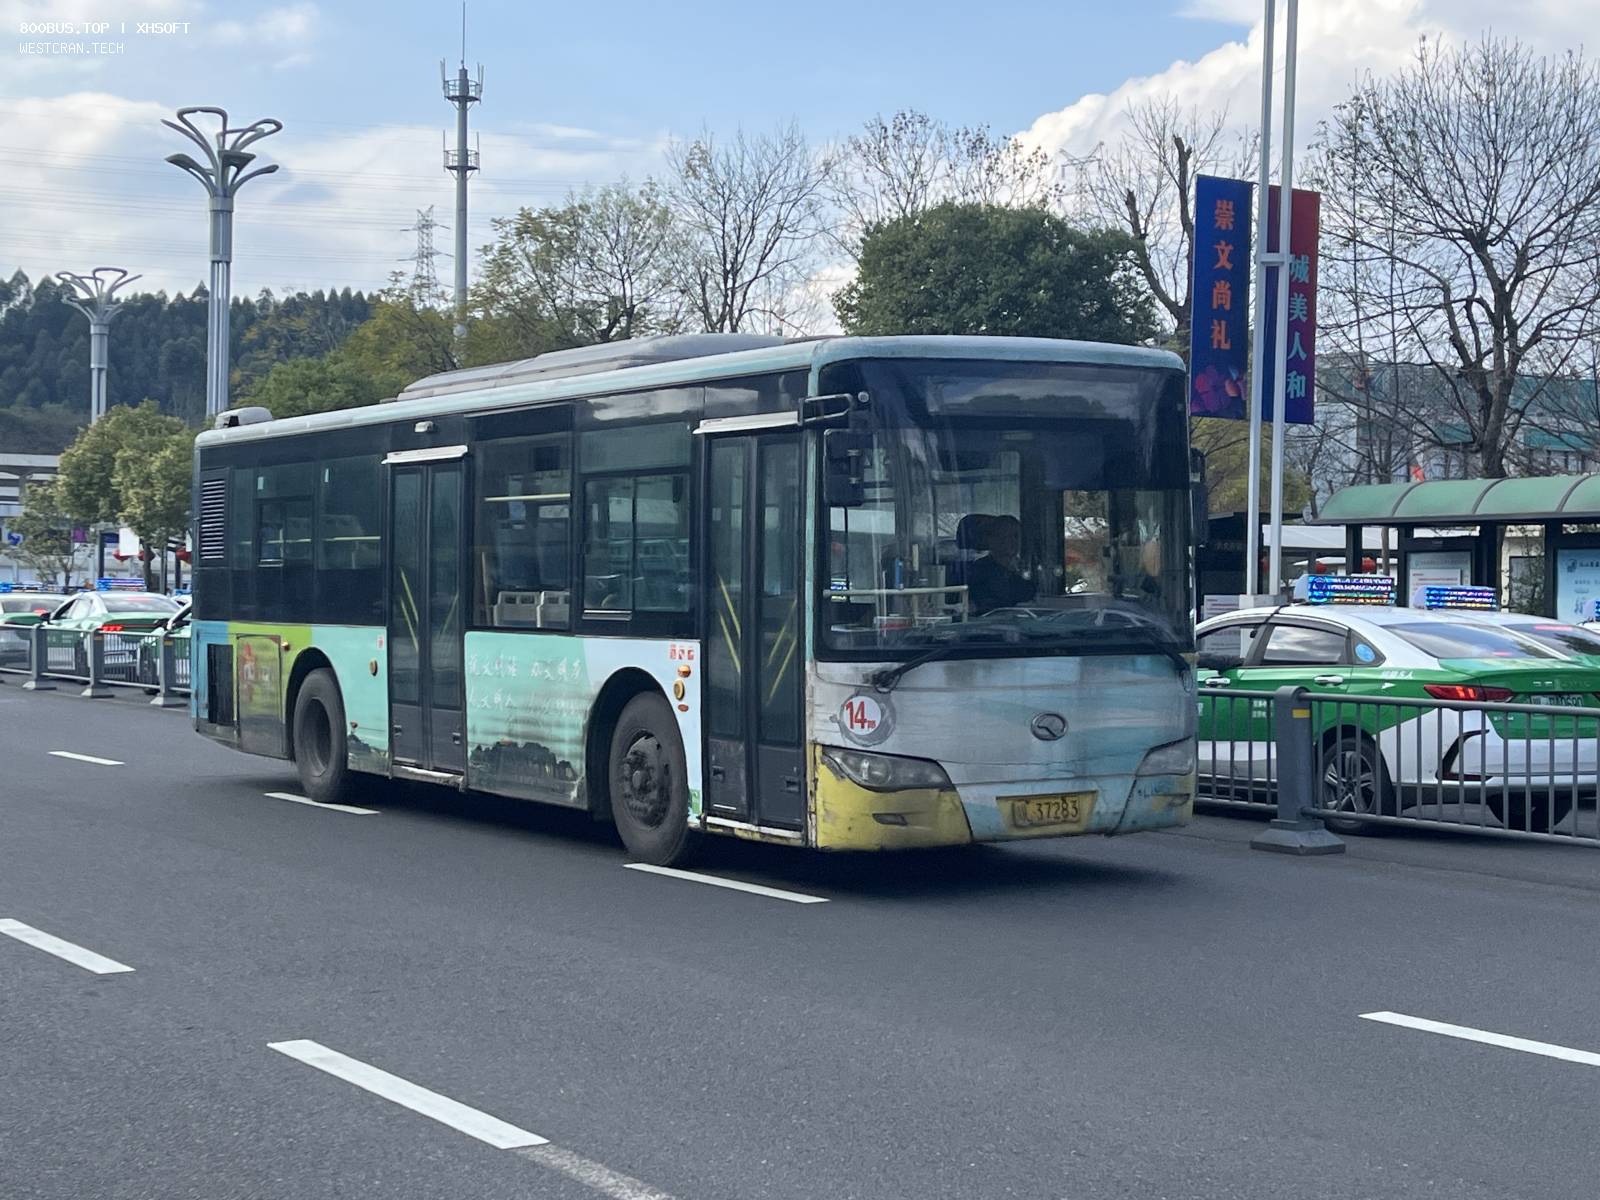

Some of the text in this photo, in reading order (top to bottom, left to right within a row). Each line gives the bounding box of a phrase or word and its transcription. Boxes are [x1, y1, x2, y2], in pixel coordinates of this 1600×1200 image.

[1210, 199, 1236, 350] 崇文尚礼
[1287, 253, 1310, 400] 城美人和
